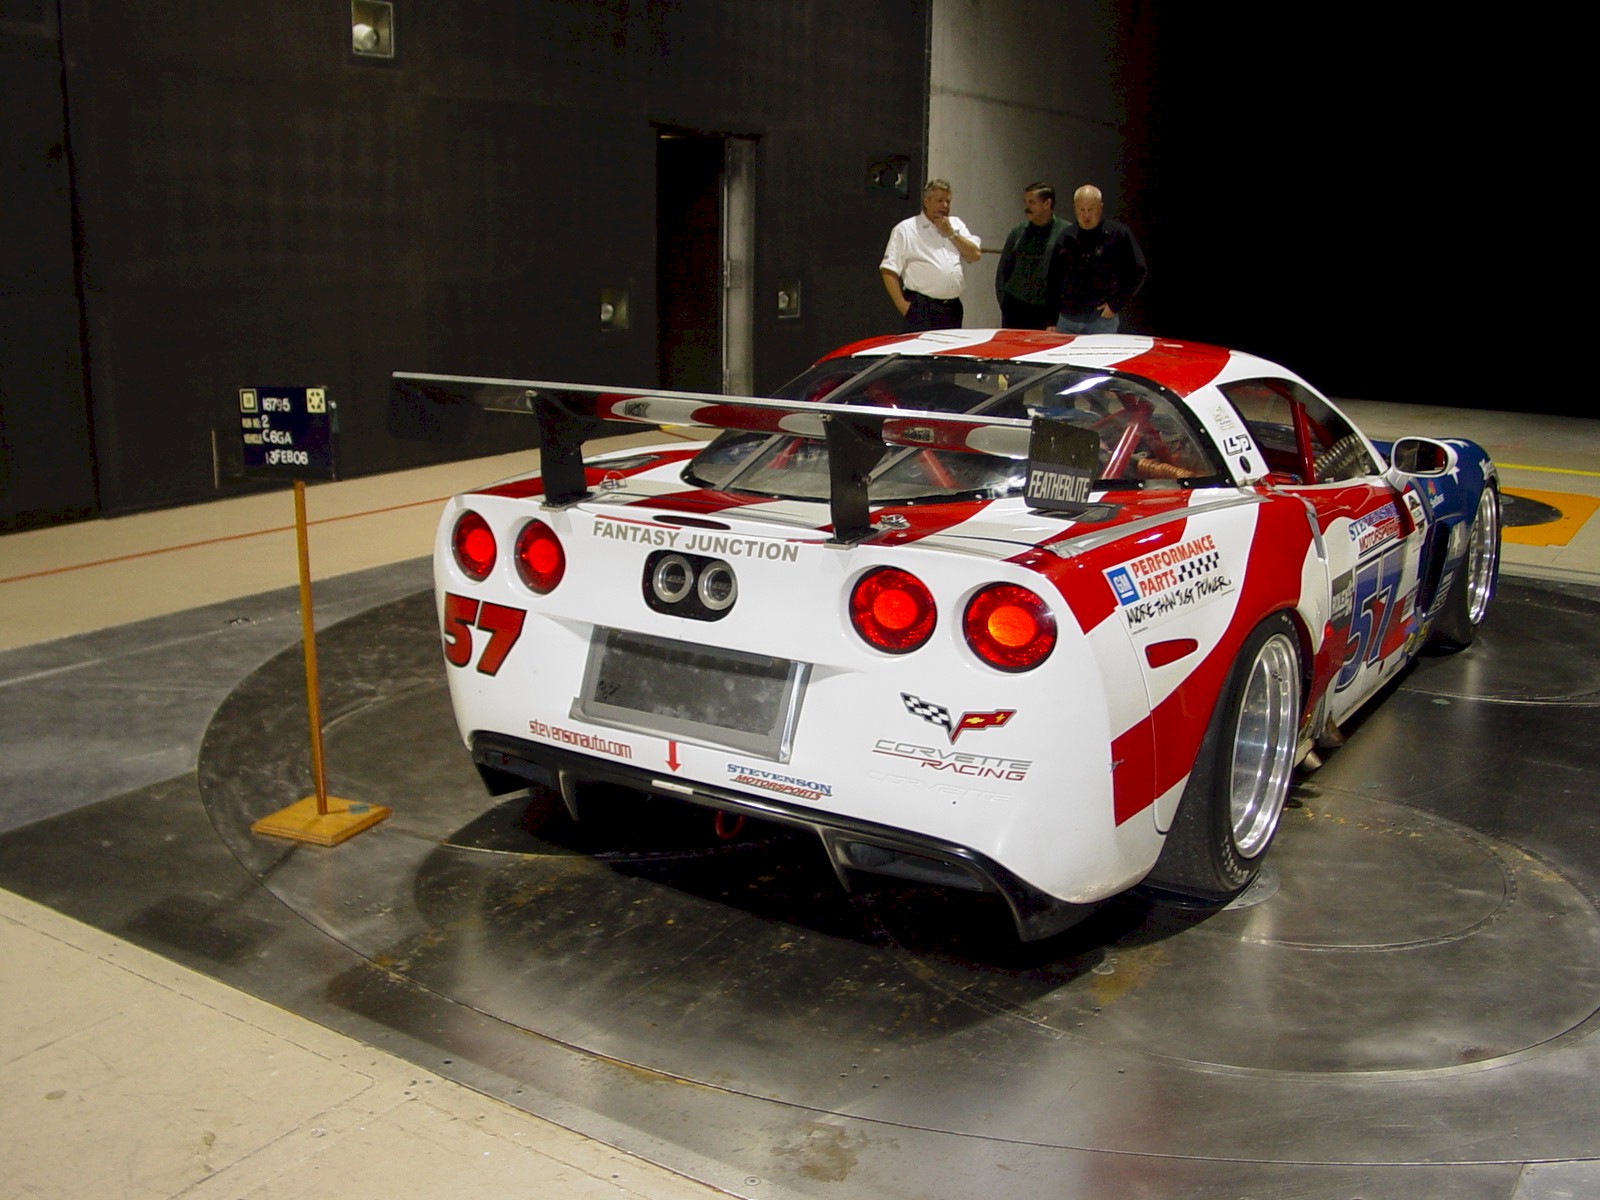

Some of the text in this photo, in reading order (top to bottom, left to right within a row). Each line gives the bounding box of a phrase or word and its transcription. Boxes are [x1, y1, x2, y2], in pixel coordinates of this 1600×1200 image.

[261, 414, 270, 428] 2
[262, 429, 293, 445] C6GA
[1028, 470, 1090, 503] FEATHERLITE
[593, 520, 799, 562] FANTASY JUNCTION
[1130, 534, 1216, 579] PERFORMANCE
[1112, 573, 1134, 594] GM
[1139, 569, 1179, 598] PARTS
[1125, 602, 1156, 629] MORE
[1334, 551, 1403, 694] 57
[443, 590, 528, 677] 57
[528, 719, 633, 759] stevensonauto.com
[874, 739, 1033, 770] CORVETTE
[727, 763, 833, 795] STEVENSON
[920, 760, 1027, 781] RACING
[735, 774, 823, 801] MOTORSPORTS
